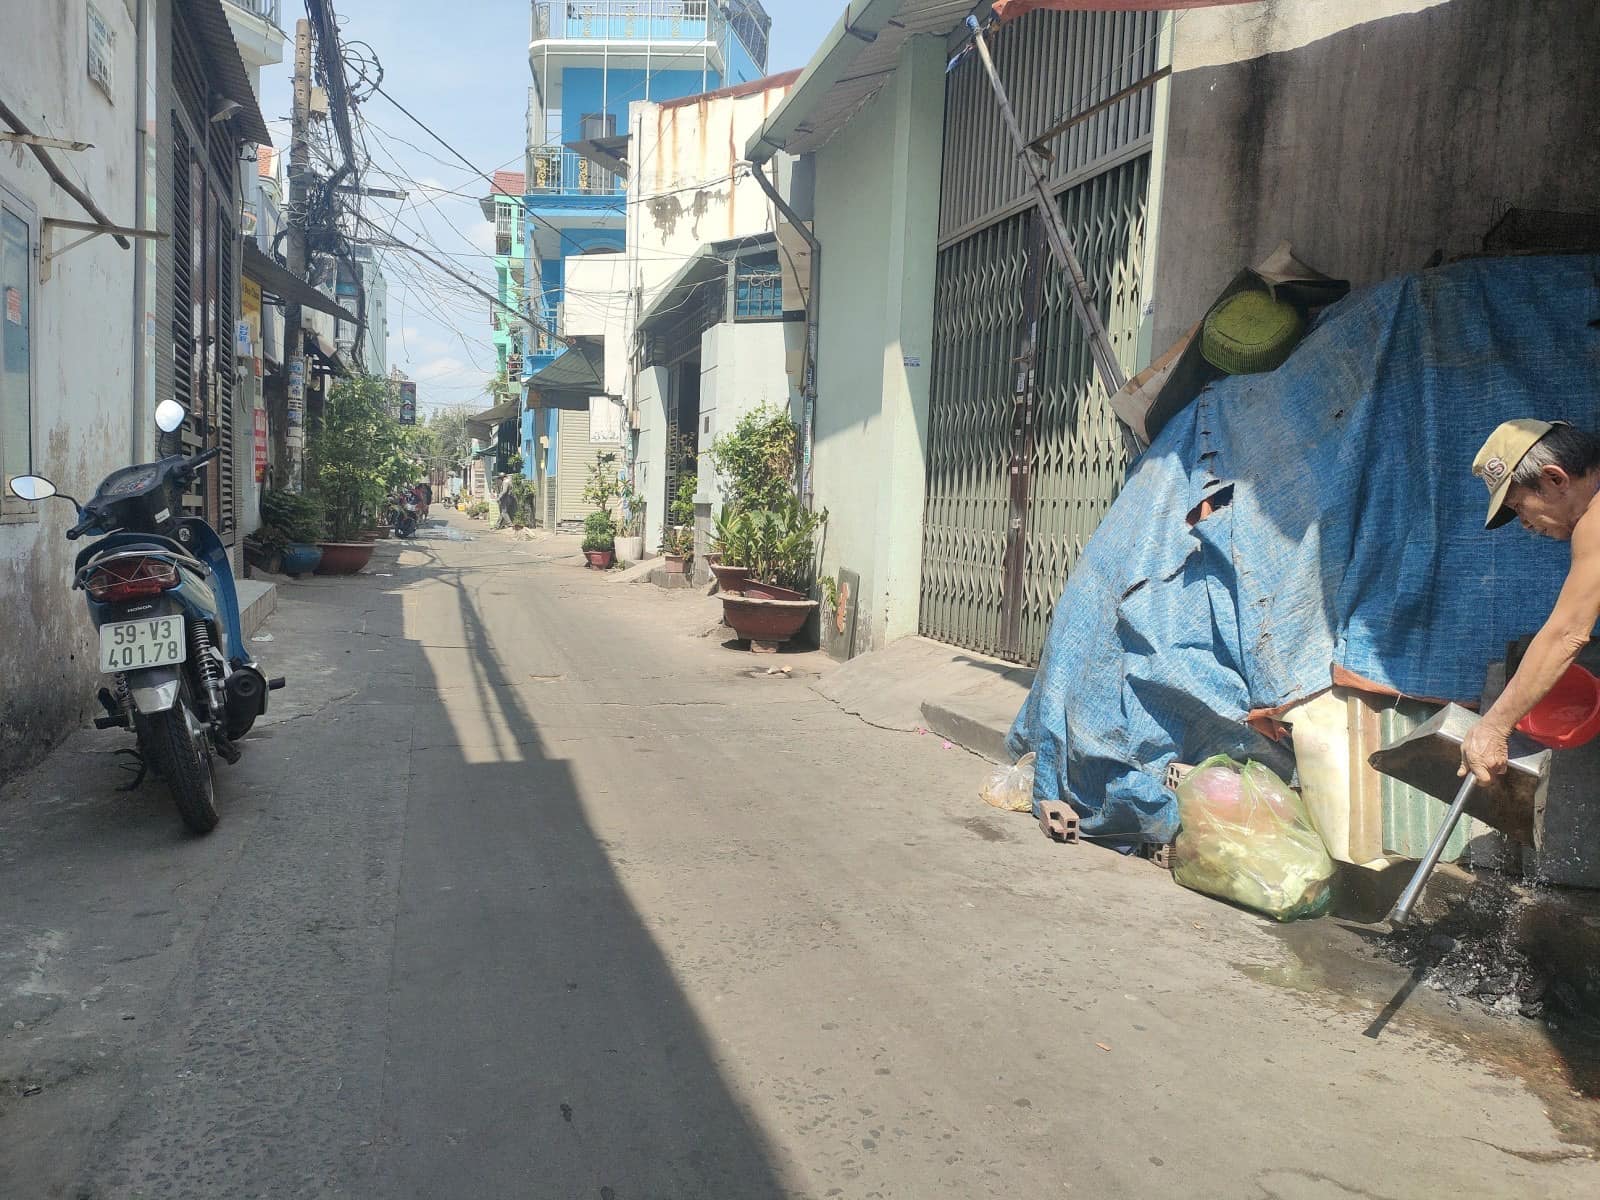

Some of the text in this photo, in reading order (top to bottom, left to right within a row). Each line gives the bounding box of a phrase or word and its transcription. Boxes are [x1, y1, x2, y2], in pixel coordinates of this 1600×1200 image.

[127, 604, 153, 613] HONDA
[113, 620, 172, 646] 59-V3
[108, 640, 178, 668] 401.78
